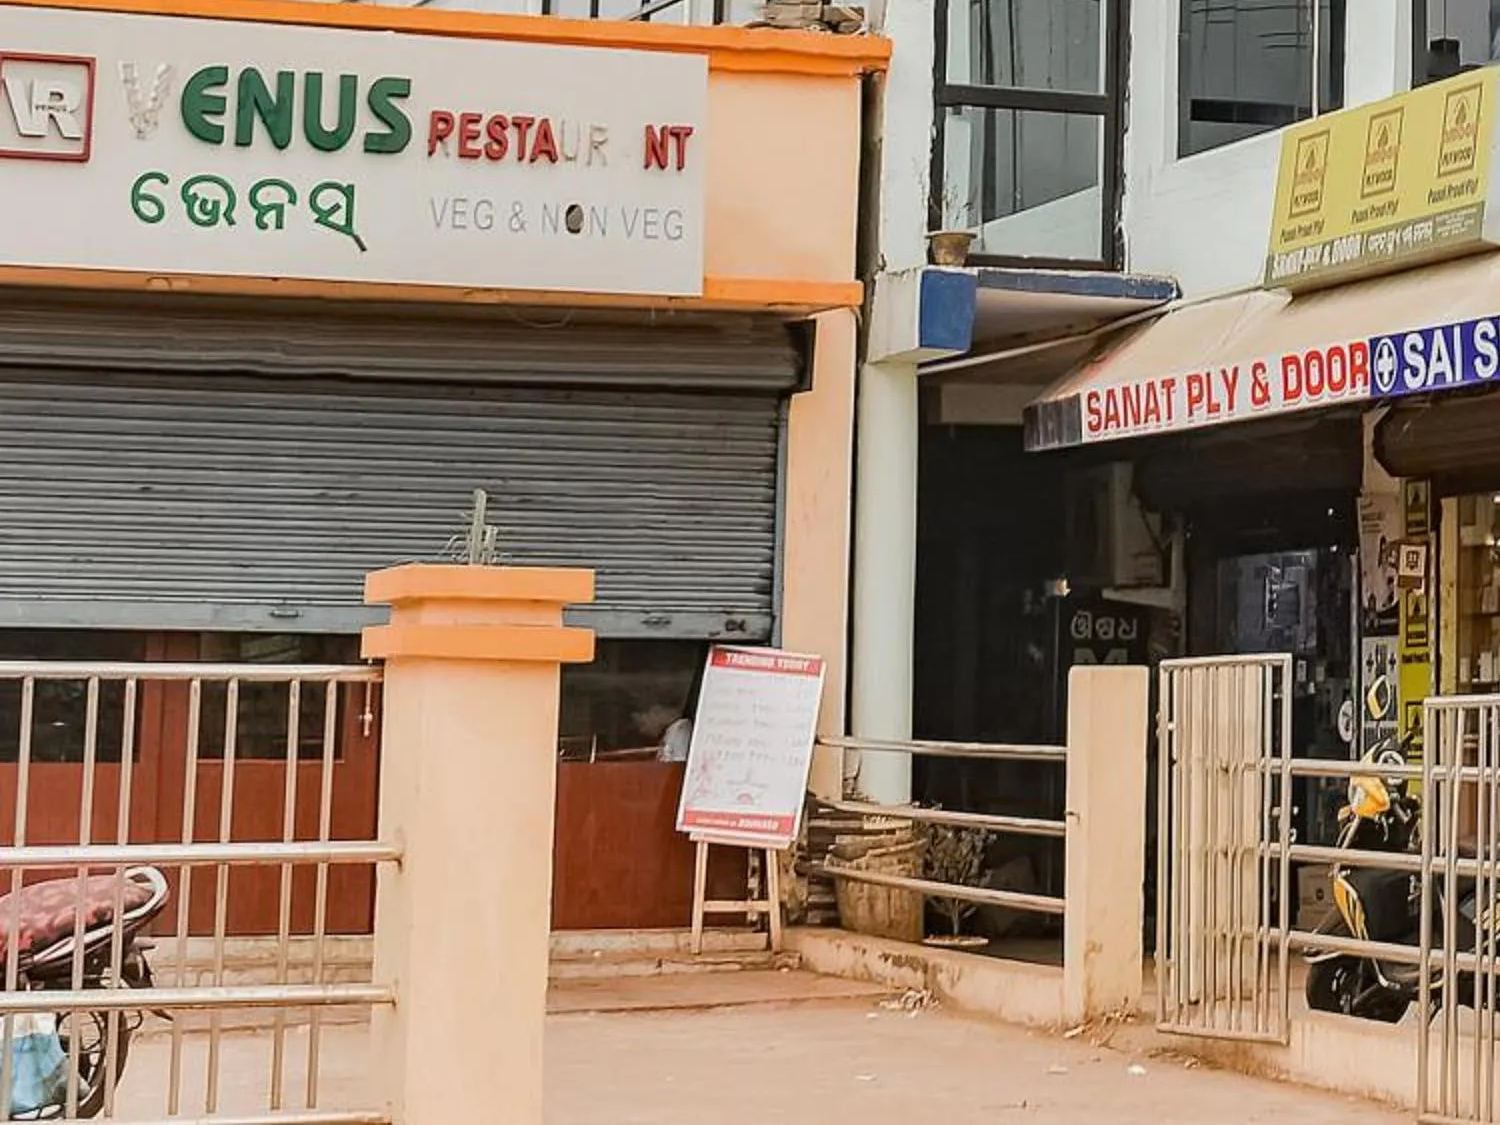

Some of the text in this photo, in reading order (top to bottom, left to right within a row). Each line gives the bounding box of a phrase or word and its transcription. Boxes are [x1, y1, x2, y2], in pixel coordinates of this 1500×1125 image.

[117, 60, 694, 172] VENUS RESTAURNT
[430, 197, 685, 241] VEG & NON VEG
[1085, 343, 1369, 433] SANAT PLY & DOOR
[1402, 338, 1463, 388] SAI
